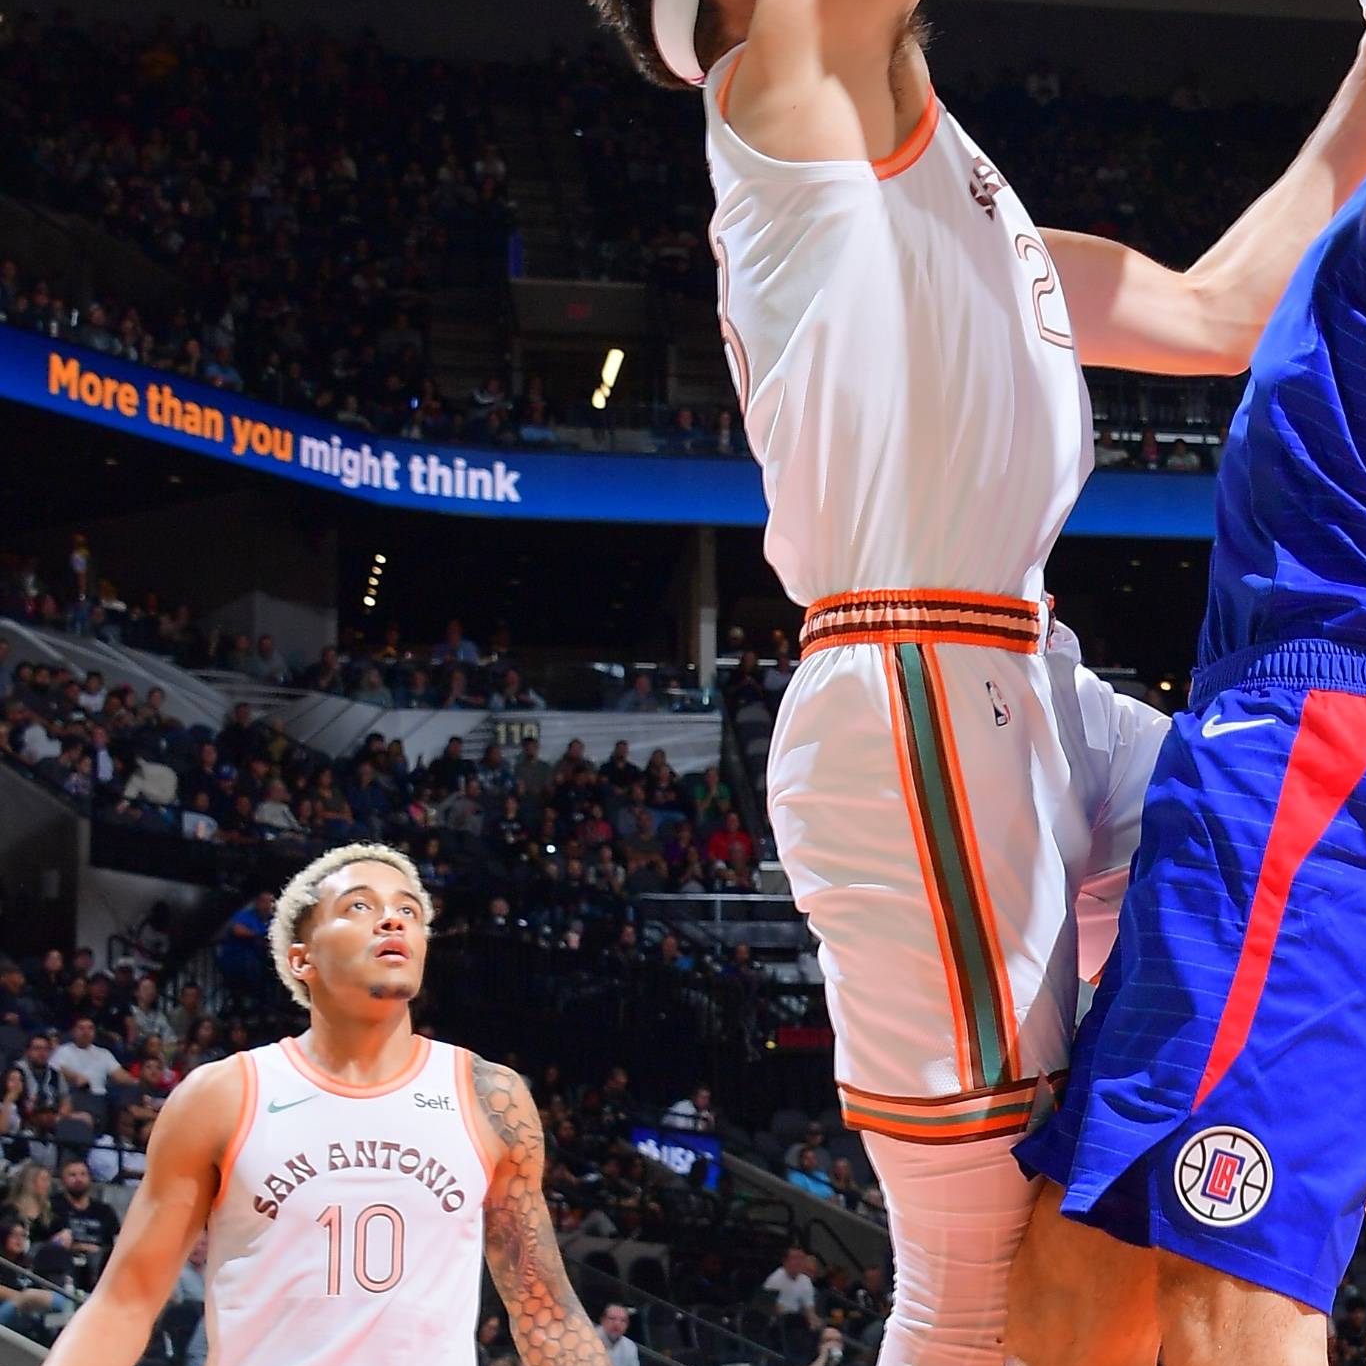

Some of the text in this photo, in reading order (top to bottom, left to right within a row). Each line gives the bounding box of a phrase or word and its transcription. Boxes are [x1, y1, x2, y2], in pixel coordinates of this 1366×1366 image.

[48, 352, 522, 503] More than you might think
[413, 1092, 456, 1112] Self.
[253, 1140, 466, 1221] SAN ANTONIO
[316, 1203, 405, 1296] 10
